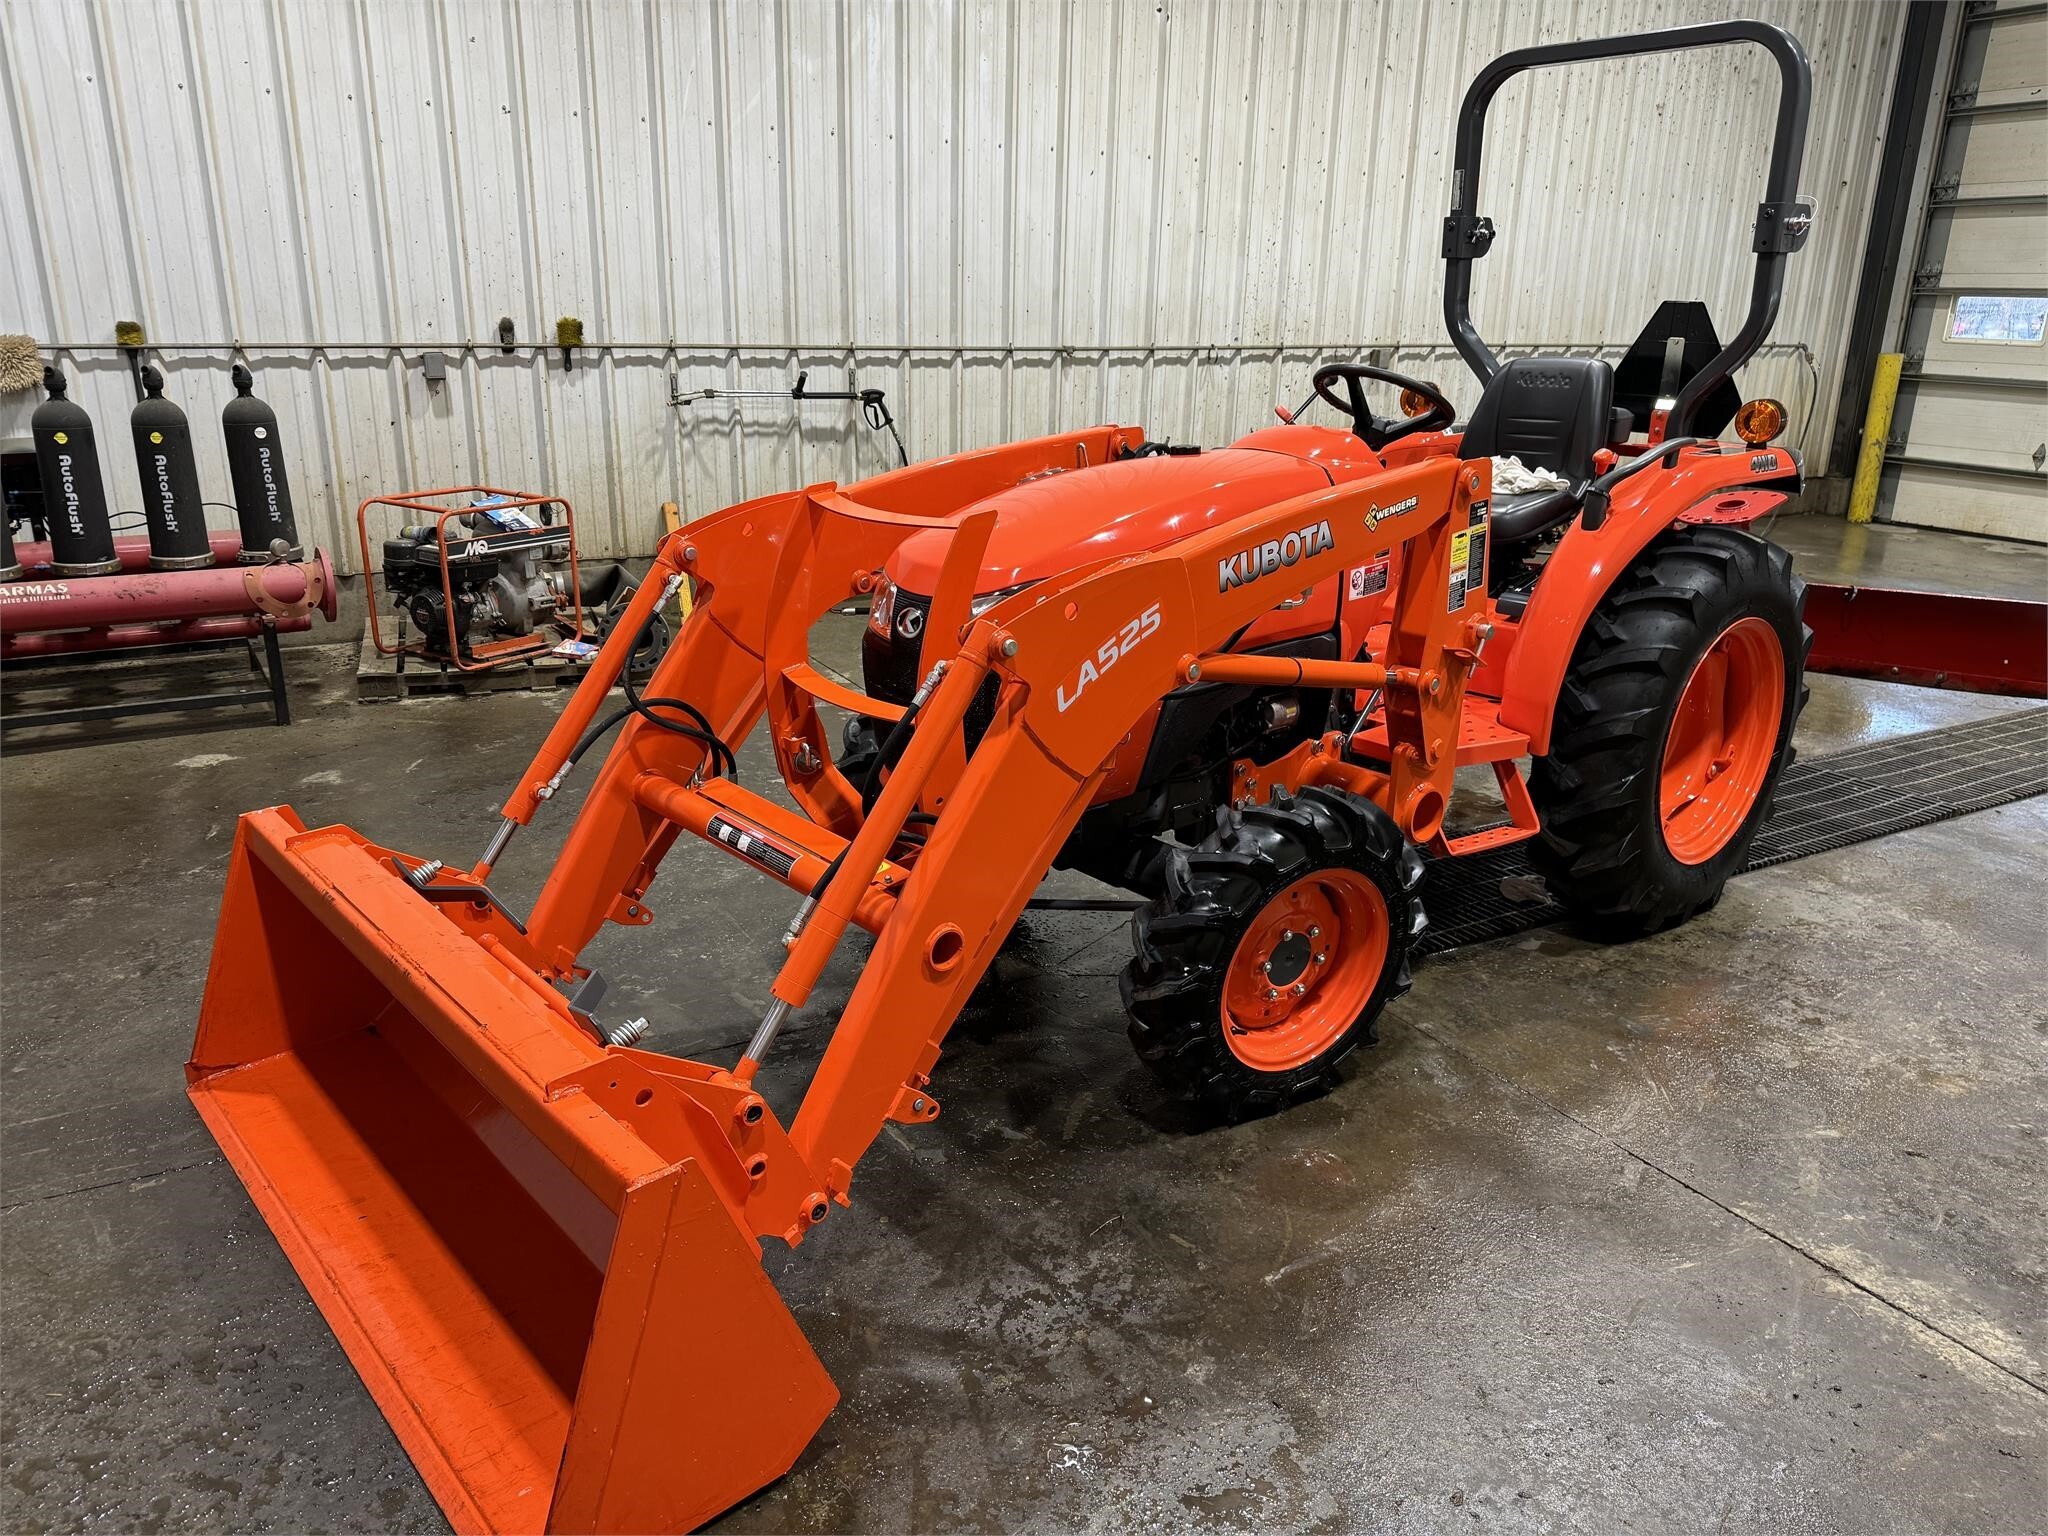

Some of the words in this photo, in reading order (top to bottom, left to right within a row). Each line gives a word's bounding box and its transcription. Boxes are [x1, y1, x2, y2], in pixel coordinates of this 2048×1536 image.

[1376, 496, 1418, 520] WENGERS
[464, 540, 489, 556] MQ
[1218, 520, 1334, 593] KUBOTA
[1056, 602, 1162, 713] LA525
